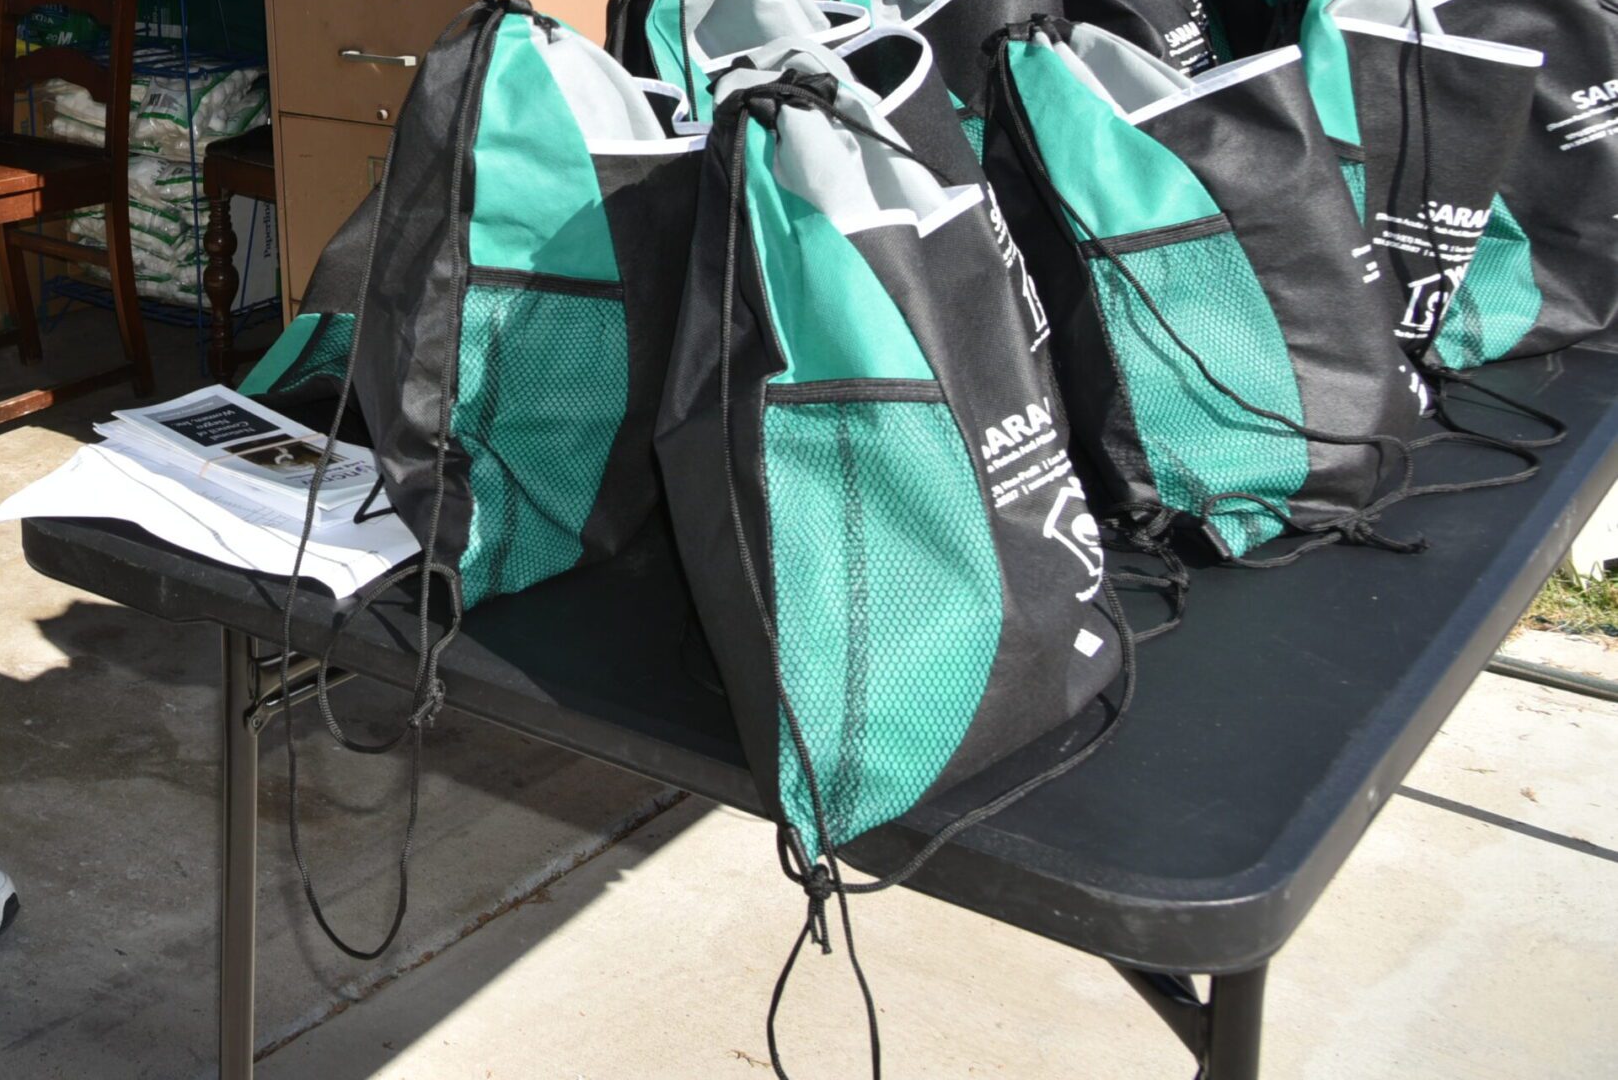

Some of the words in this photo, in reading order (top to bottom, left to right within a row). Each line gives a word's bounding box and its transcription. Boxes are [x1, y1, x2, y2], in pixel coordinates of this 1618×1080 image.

[57, 31, 74, 46] M
[195, 418, 231, 430] Negro
[209, 420, 251, 436] Council
[196, 430, 208, 438] of
[208, 426, 257, 441] National
